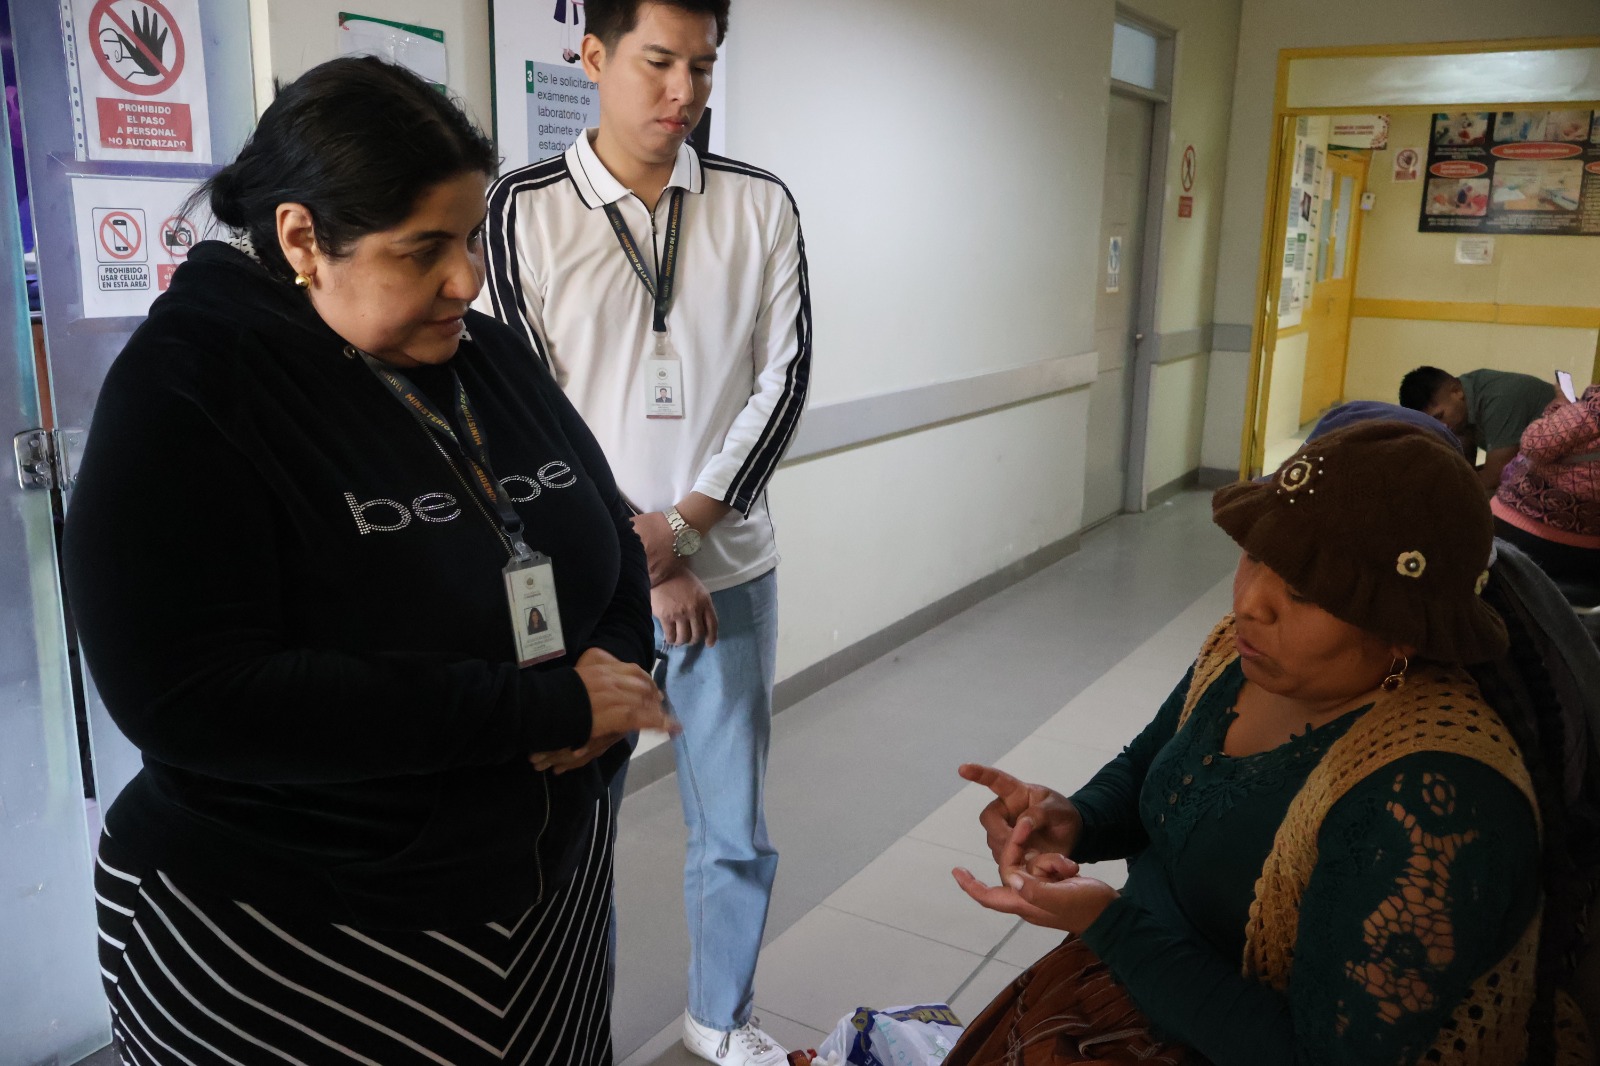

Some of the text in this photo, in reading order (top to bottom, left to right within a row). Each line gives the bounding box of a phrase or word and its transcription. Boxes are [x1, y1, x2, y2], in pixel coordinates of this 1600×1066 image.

[527, 70, 533, 82] 3
[537, 71, 548, 84] Se
[550, 73, 558, 85] le
[580, 94, 591, 105] de
[118, 103, 172, 115] PROHIBIDO
[537, 105, 588, 124] laboratorio y
[126, 115, 166, 126] EL PASO
[117, 126, 177, 137] A PERSONAL
[538, 123, 573, 137] gabinete
[108, 137, 187, 148] NO AUTORIZADO
[538, 140, 567, 152] estado
[670, 227, 677, 236] LA
[669, 236, 676, 245] DE
[620, 232, 639, 263] MINISTERIO
[636, 262, 643, 271] DE
[640, 269, 649, 279] LA
[100, 273, 148, 282] USAR CELULAR
[130, 280, 147, 288] AREA
[404, 392, 450, 432] MINISTERIO
[460, 404, 483, 446] MINISTERIO
[344, 491, 461, 535] be
